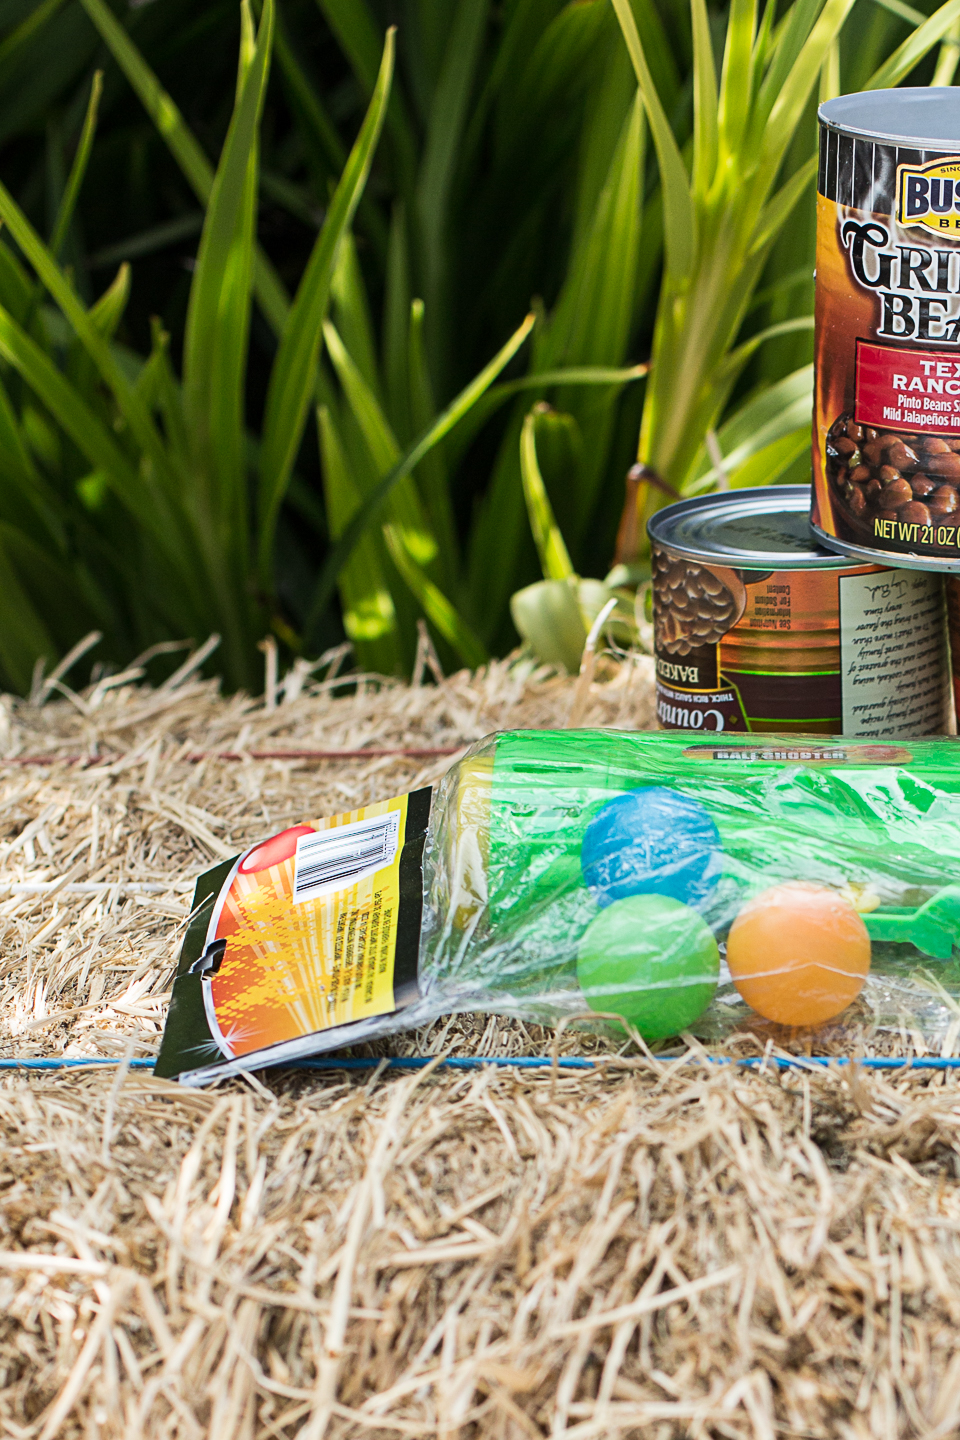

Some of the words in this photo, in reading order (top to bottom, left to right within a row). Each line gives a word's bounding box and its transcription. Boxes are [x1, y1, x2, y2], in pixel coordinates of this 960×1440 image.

[897, 394, 921, 410] Pinto
[923, 397, 952, 413] Beans
[882, 406, 901, 421] Mild
[902, 409, 949, 426] Jalapeños
[950, 413, 960, 427] in
[875, 518, 898, 540] NET
[898, 521, 921, 543] WT
[920, 526, 935, 544] 21
[938, 526, 956, 546] OZ
[766, 584, 790, 595] Content
[754, 596, 777, 606] Sodium
[780, 597, 791, 606] For
[754, 607, 791, 617] Information
[863, 608, 883, 617] time.
[750, 618, 777, 629] Nutrition
[779, 619, 791, 630] See
[855, 617, 881, 632] flavor
[880, 619, 893, 630] the
[852, 637, 873, 646] than
[874, 633, 893, 642] more
[857, 643, 885, 660] family
[847, 661, 857, 676] of
[858, 656, 889, 672] greatest
[889, 658, 901, 668] the
[853, 674, 875, 686] using
[876, 671, 903, 684] cooked,
[709, 693, 734, 703] THICK,
[852, 697, 887, 715] guarded
[659, 701, 724, 731] Count
[860, 714, 884, 726] recipe
